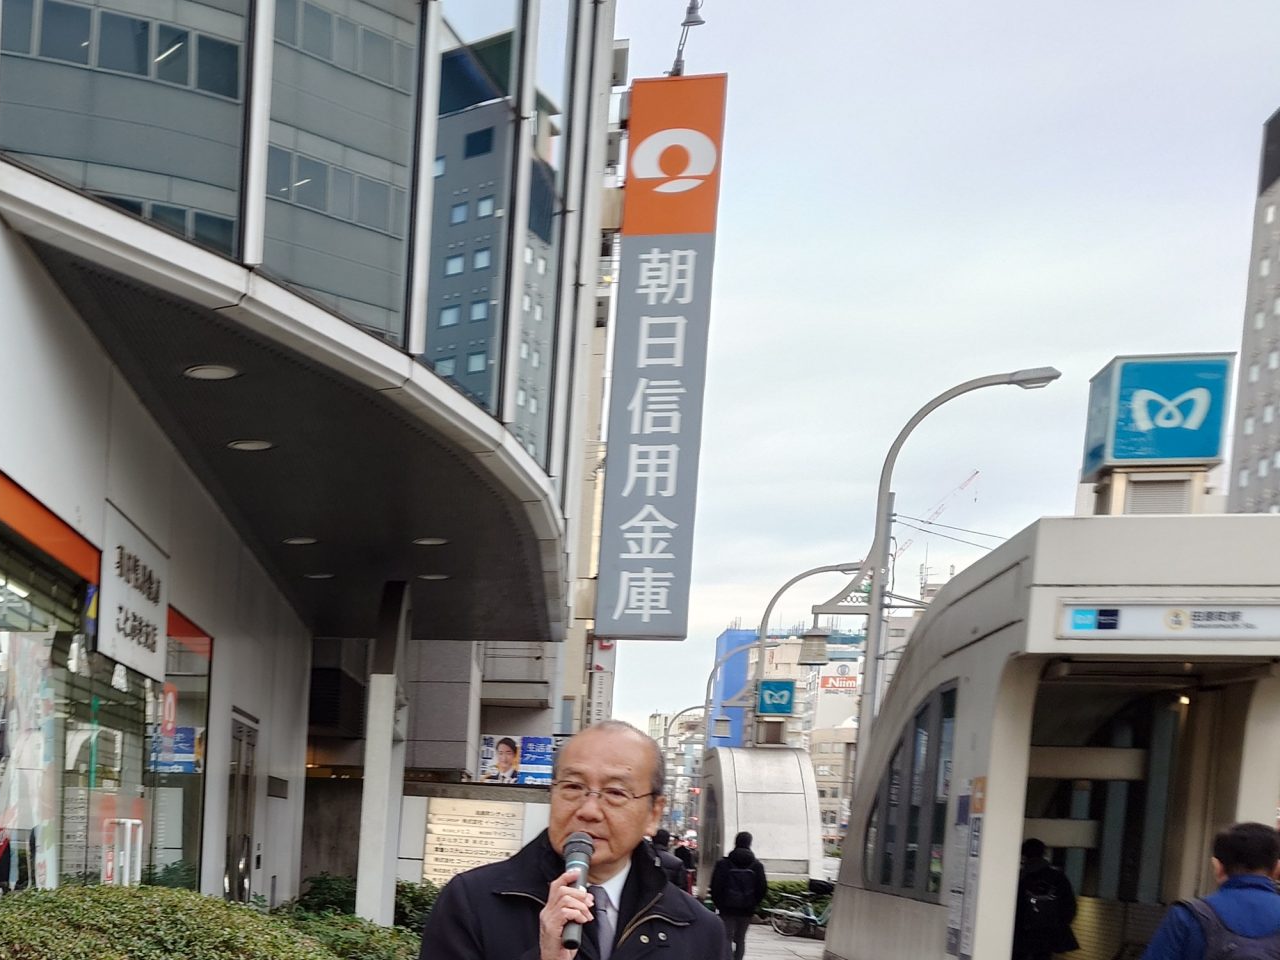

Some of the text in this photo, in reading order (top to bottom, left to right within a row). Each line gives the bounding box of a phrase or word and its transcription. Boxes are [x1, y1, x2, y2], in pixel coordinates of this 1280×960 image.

[612, 247, 699, 623] 朝日信用金庫
